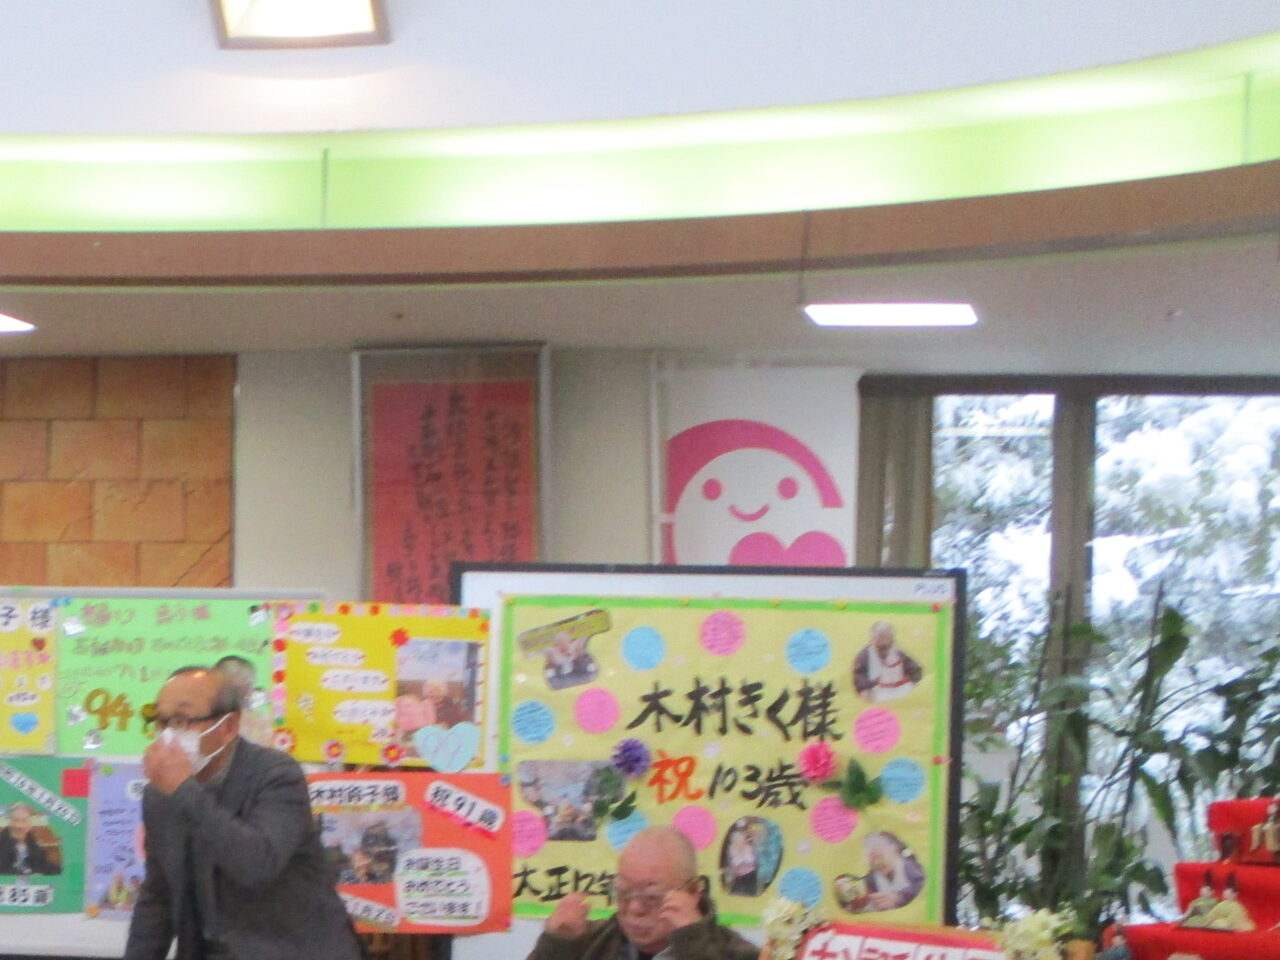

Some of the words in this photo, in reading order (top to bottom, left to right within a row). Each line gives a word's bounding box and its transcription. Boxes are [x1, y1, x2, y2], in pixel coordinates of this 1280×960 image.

[626, 674, 844, 742] 木村きく様
